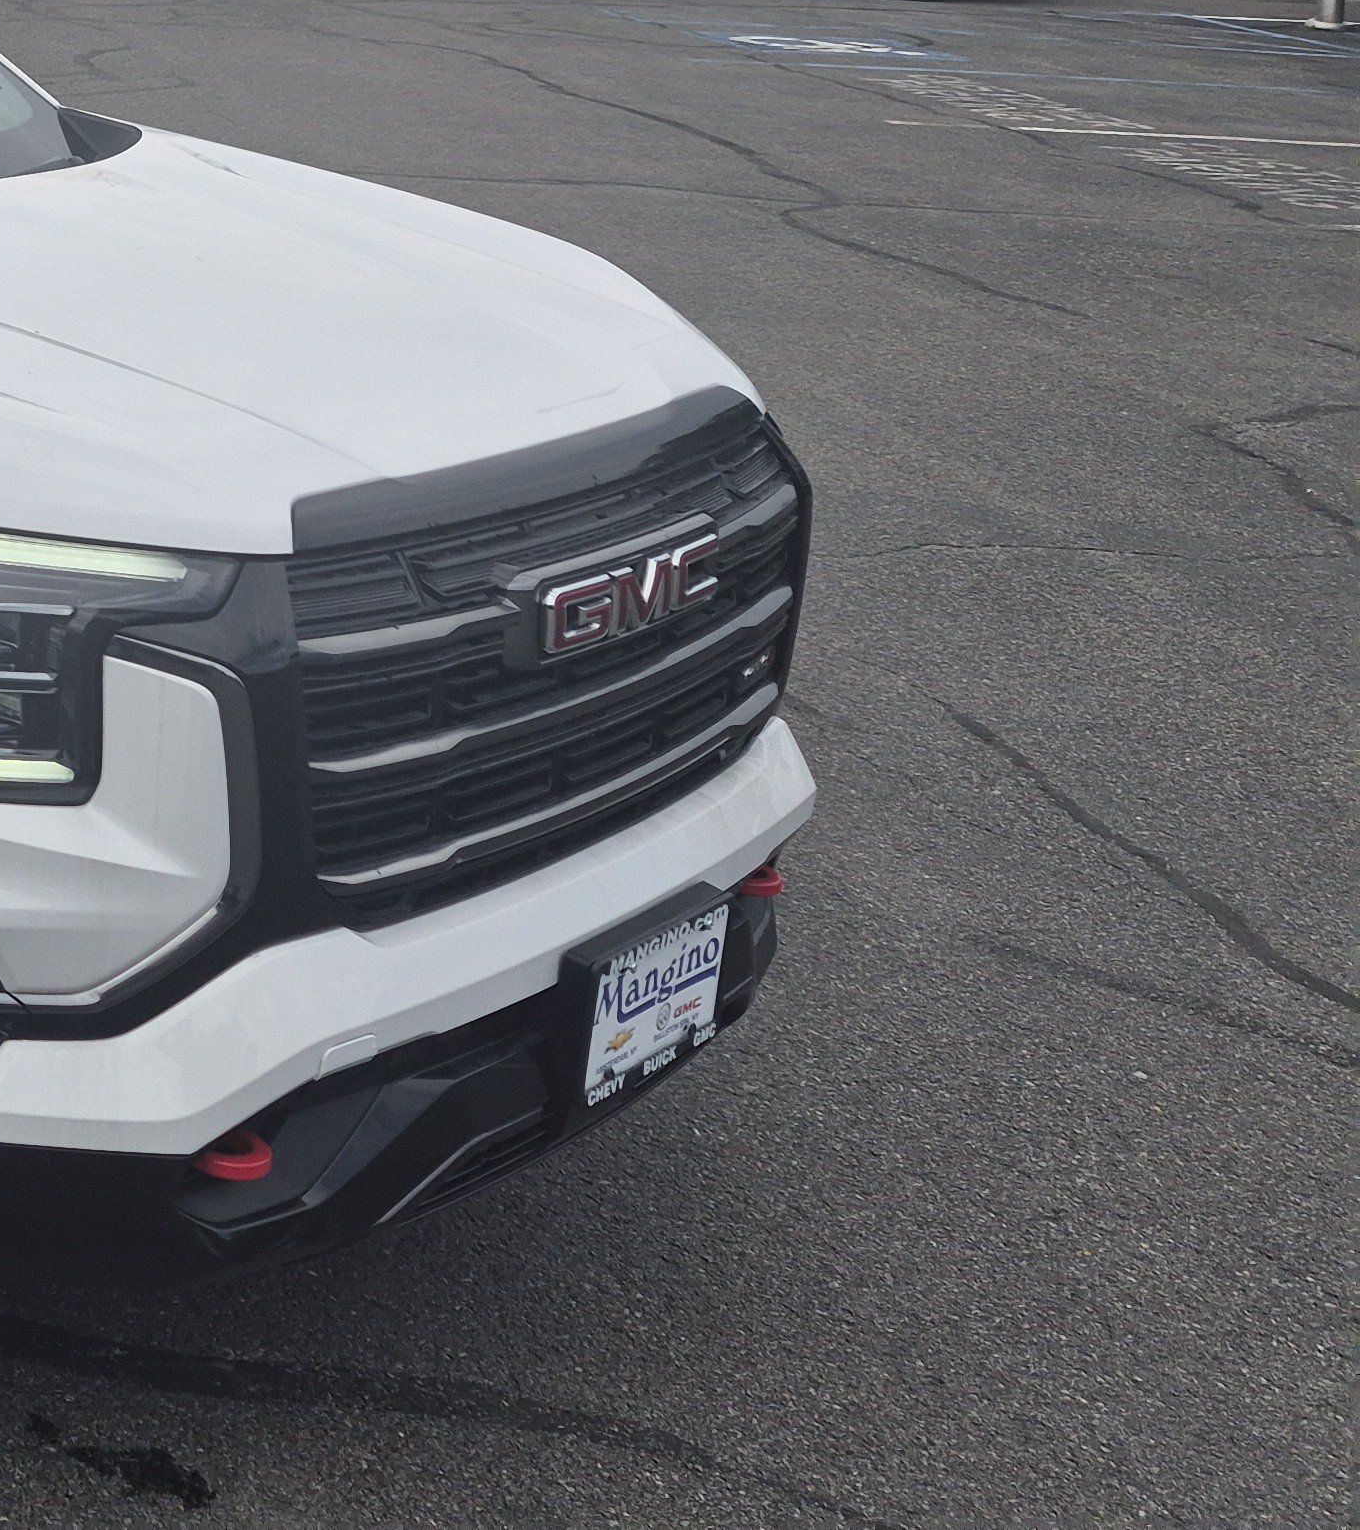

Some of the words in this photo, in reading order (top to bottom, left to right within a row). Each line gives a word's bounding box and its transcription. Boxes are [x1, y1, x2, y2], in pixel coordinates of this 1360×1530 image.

[543, 533, 719, 654] GMC
[594, 937, 720, 1024] Mangino
[673, 995, 702, 1019] GMC
[587, 1073, 626, 1107] CHEVY
[642, 1045, 678, 1076] BUICK
[693, 1022, 717, 1048] GMC
